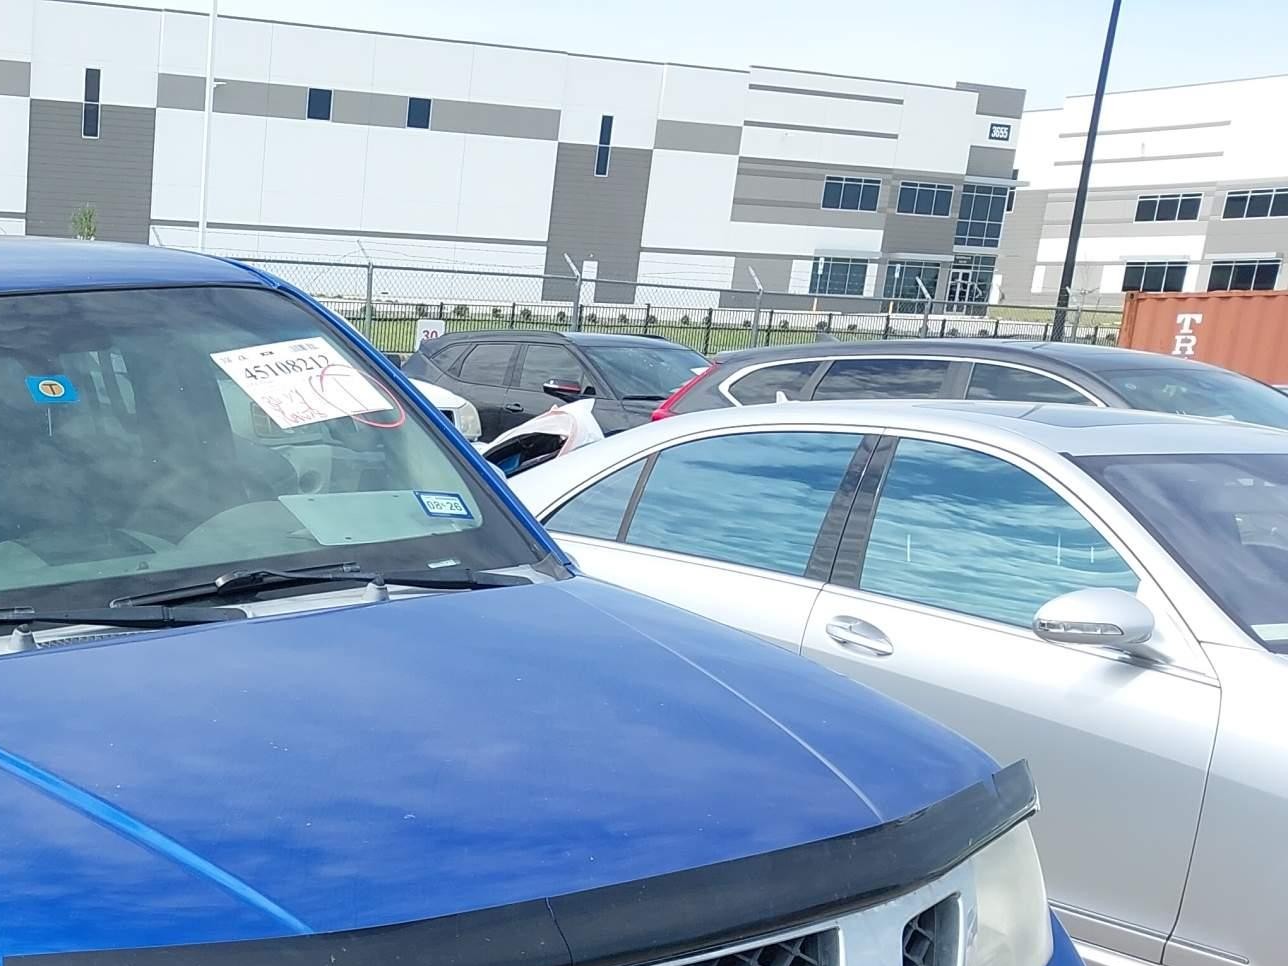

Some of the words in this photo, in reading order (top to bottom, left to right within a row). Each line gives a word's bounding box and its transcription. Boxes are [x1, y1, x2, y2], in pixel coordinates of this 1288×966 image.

[422, 330, 438, 339] 30
[1171, 313, 1203, 358] TR
[42, 383, 58, 395] T
